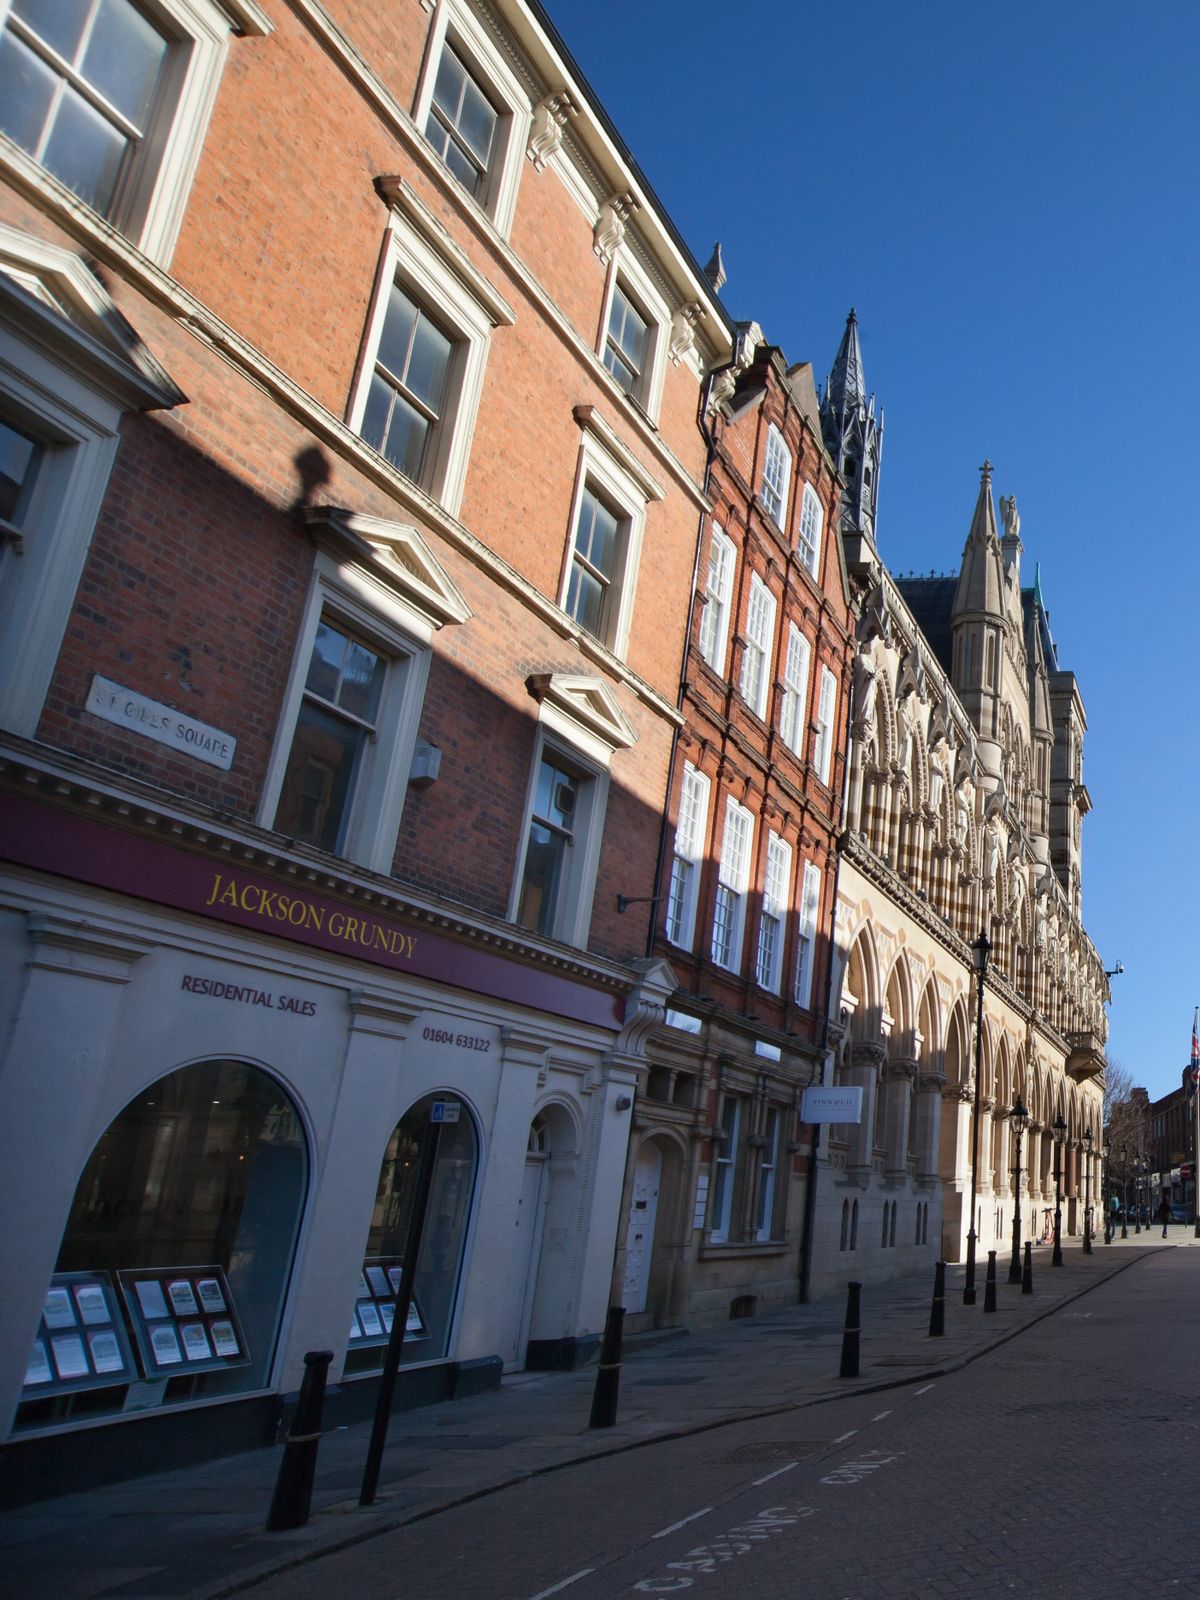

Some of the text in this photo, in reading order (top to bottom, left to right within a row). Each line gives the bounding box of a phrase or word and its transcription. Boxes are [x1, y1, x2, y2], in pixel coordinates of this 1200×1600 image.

[176, 724, 229, 759] SQUARE
[206, 873, 418, 959] JACKSON GRUNDY
[181, 974, 317, 1017] RESIDENTIAL SALES
[422, 1027, 491, 1053] 01604 633122
